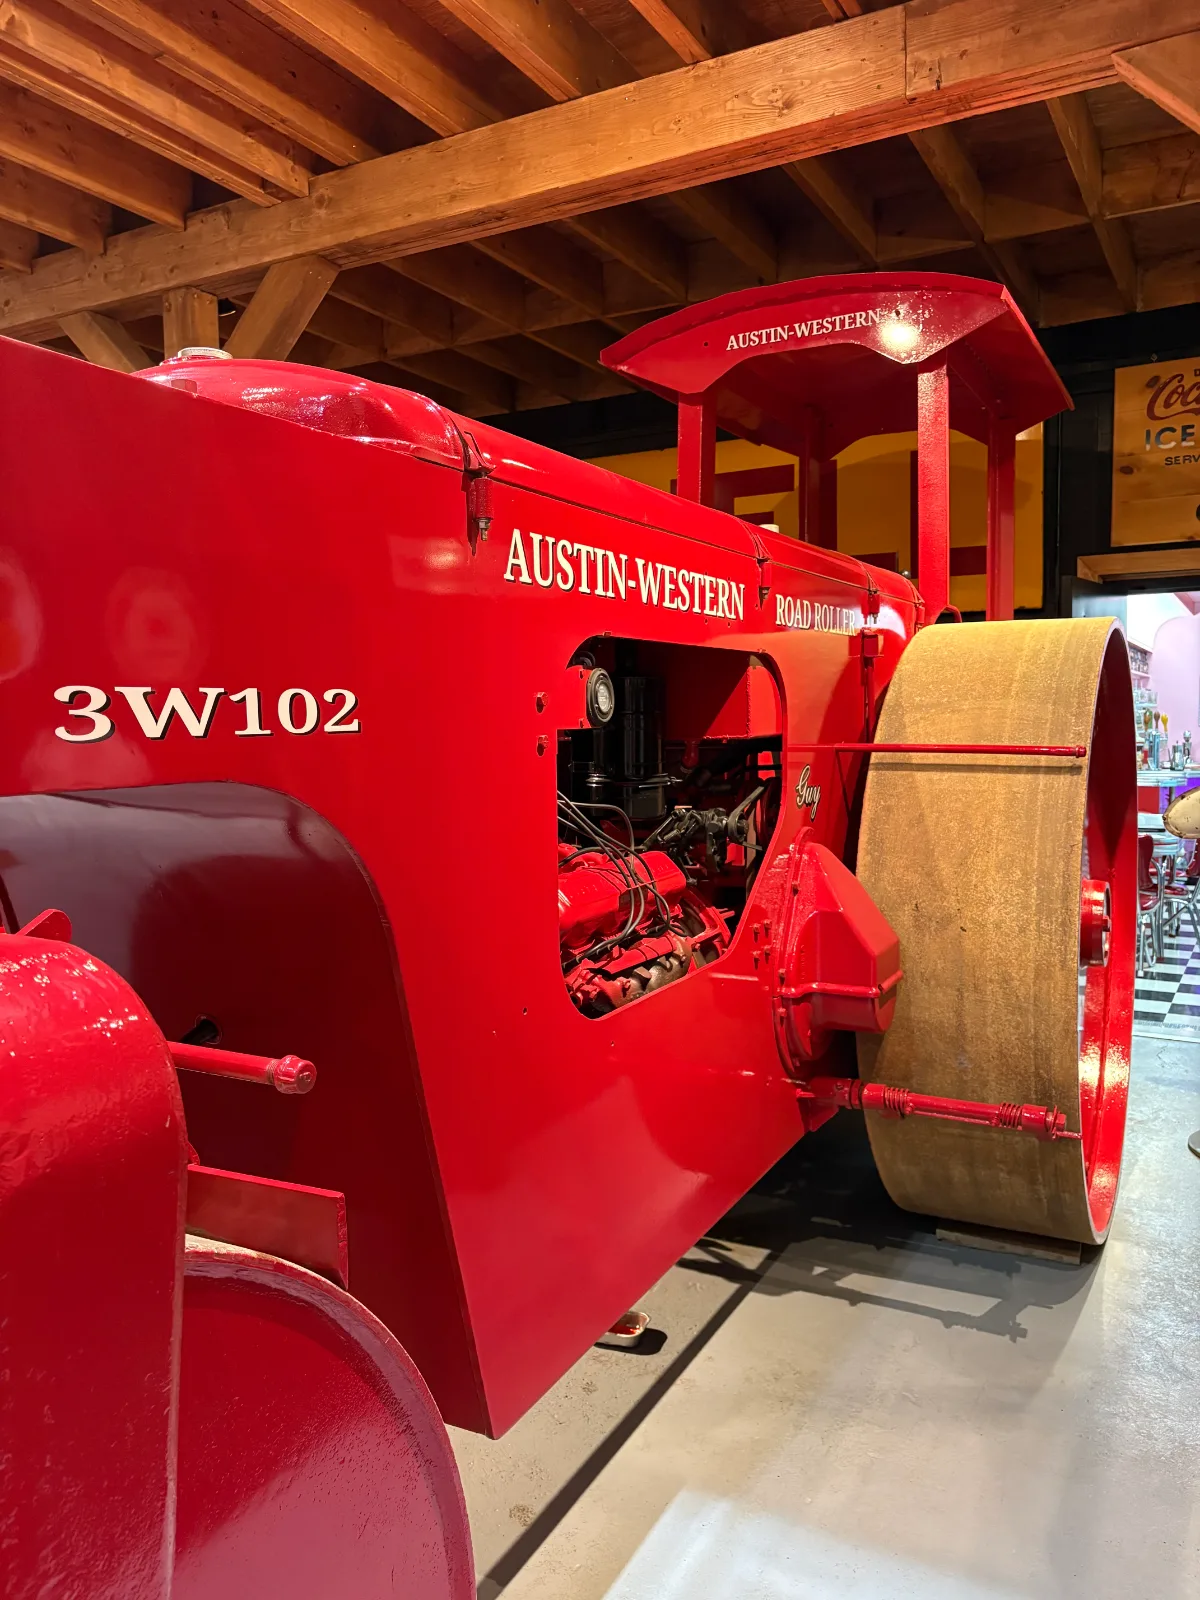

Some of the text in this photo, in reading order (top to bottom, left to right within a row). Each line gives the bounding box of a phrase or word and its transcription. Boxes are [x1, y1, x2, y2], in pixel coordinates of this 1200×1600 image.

[726, 308, 882, 352] AUSTIN-WESTERN
[1145, 424, 1196, 452] ICE
[503, 527, 745, 621] AUSTIN-WESTERN
[775, 594, 857, 637] ROAD ROLLER
[53, 685, 361, 744] 3W102
[795, 763, 821, 822] Guy
